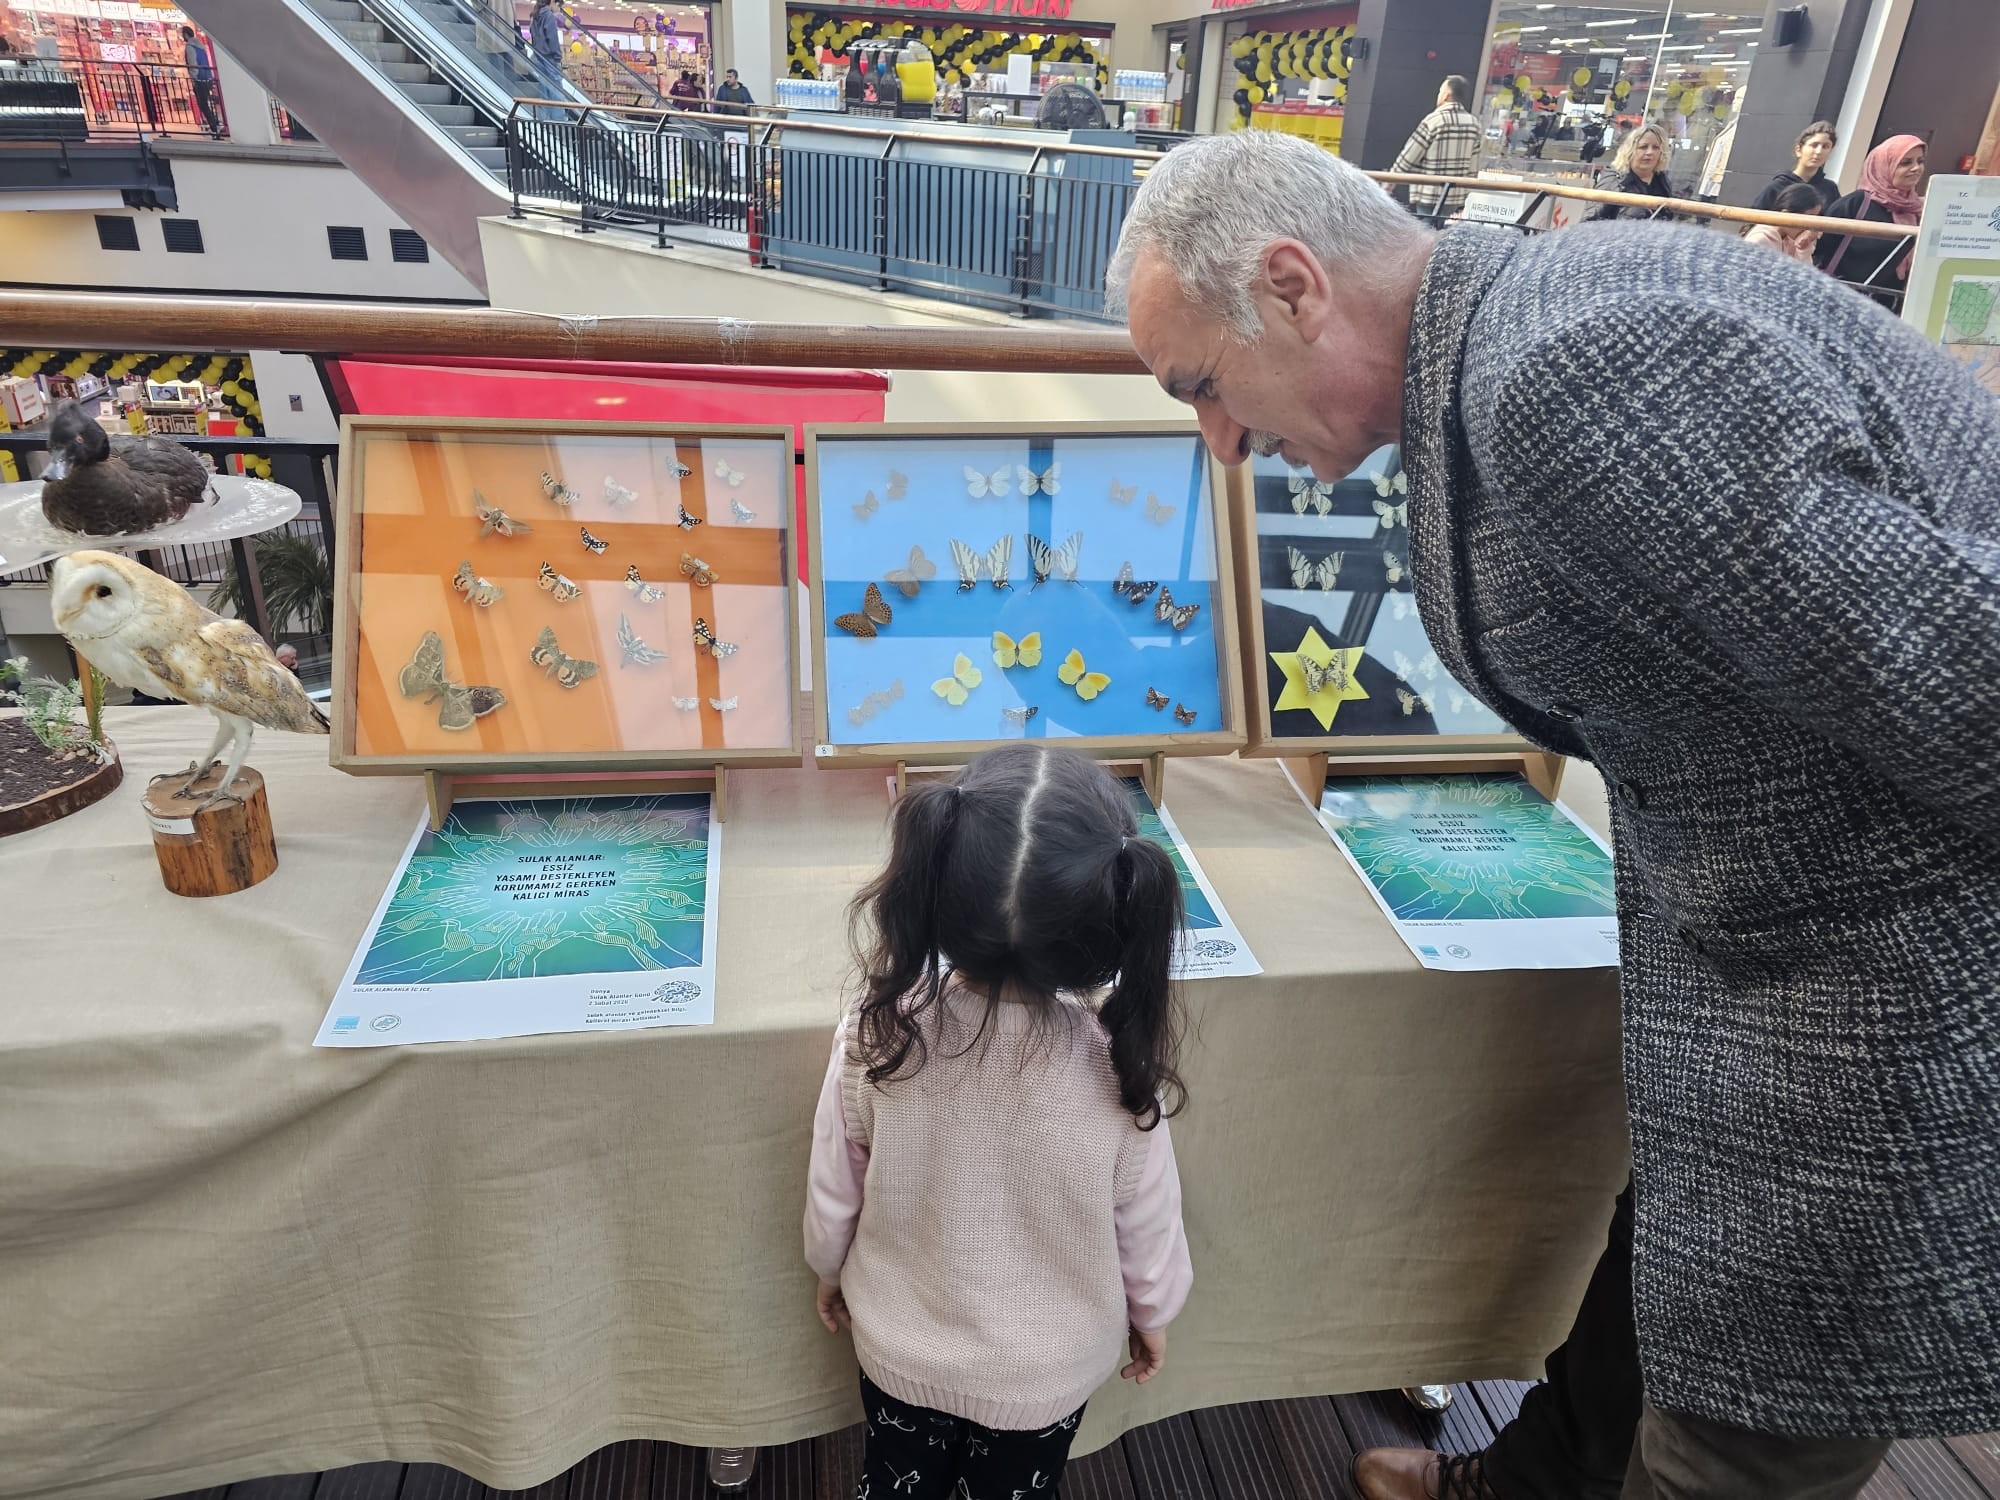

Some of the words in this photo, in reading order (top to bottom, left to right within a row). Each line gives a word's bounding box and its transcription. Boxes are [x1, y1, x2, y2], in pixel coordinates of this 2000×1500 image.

[518, 856, 552, 864] SULAK
[540, 870, 616, 882] DESTEKLEYEN
[494, 882, 562, 892] KORUMAMIZ
[566, 880, 616, 888] GEREKEN
[512, 892, 550, 900] KALICI
